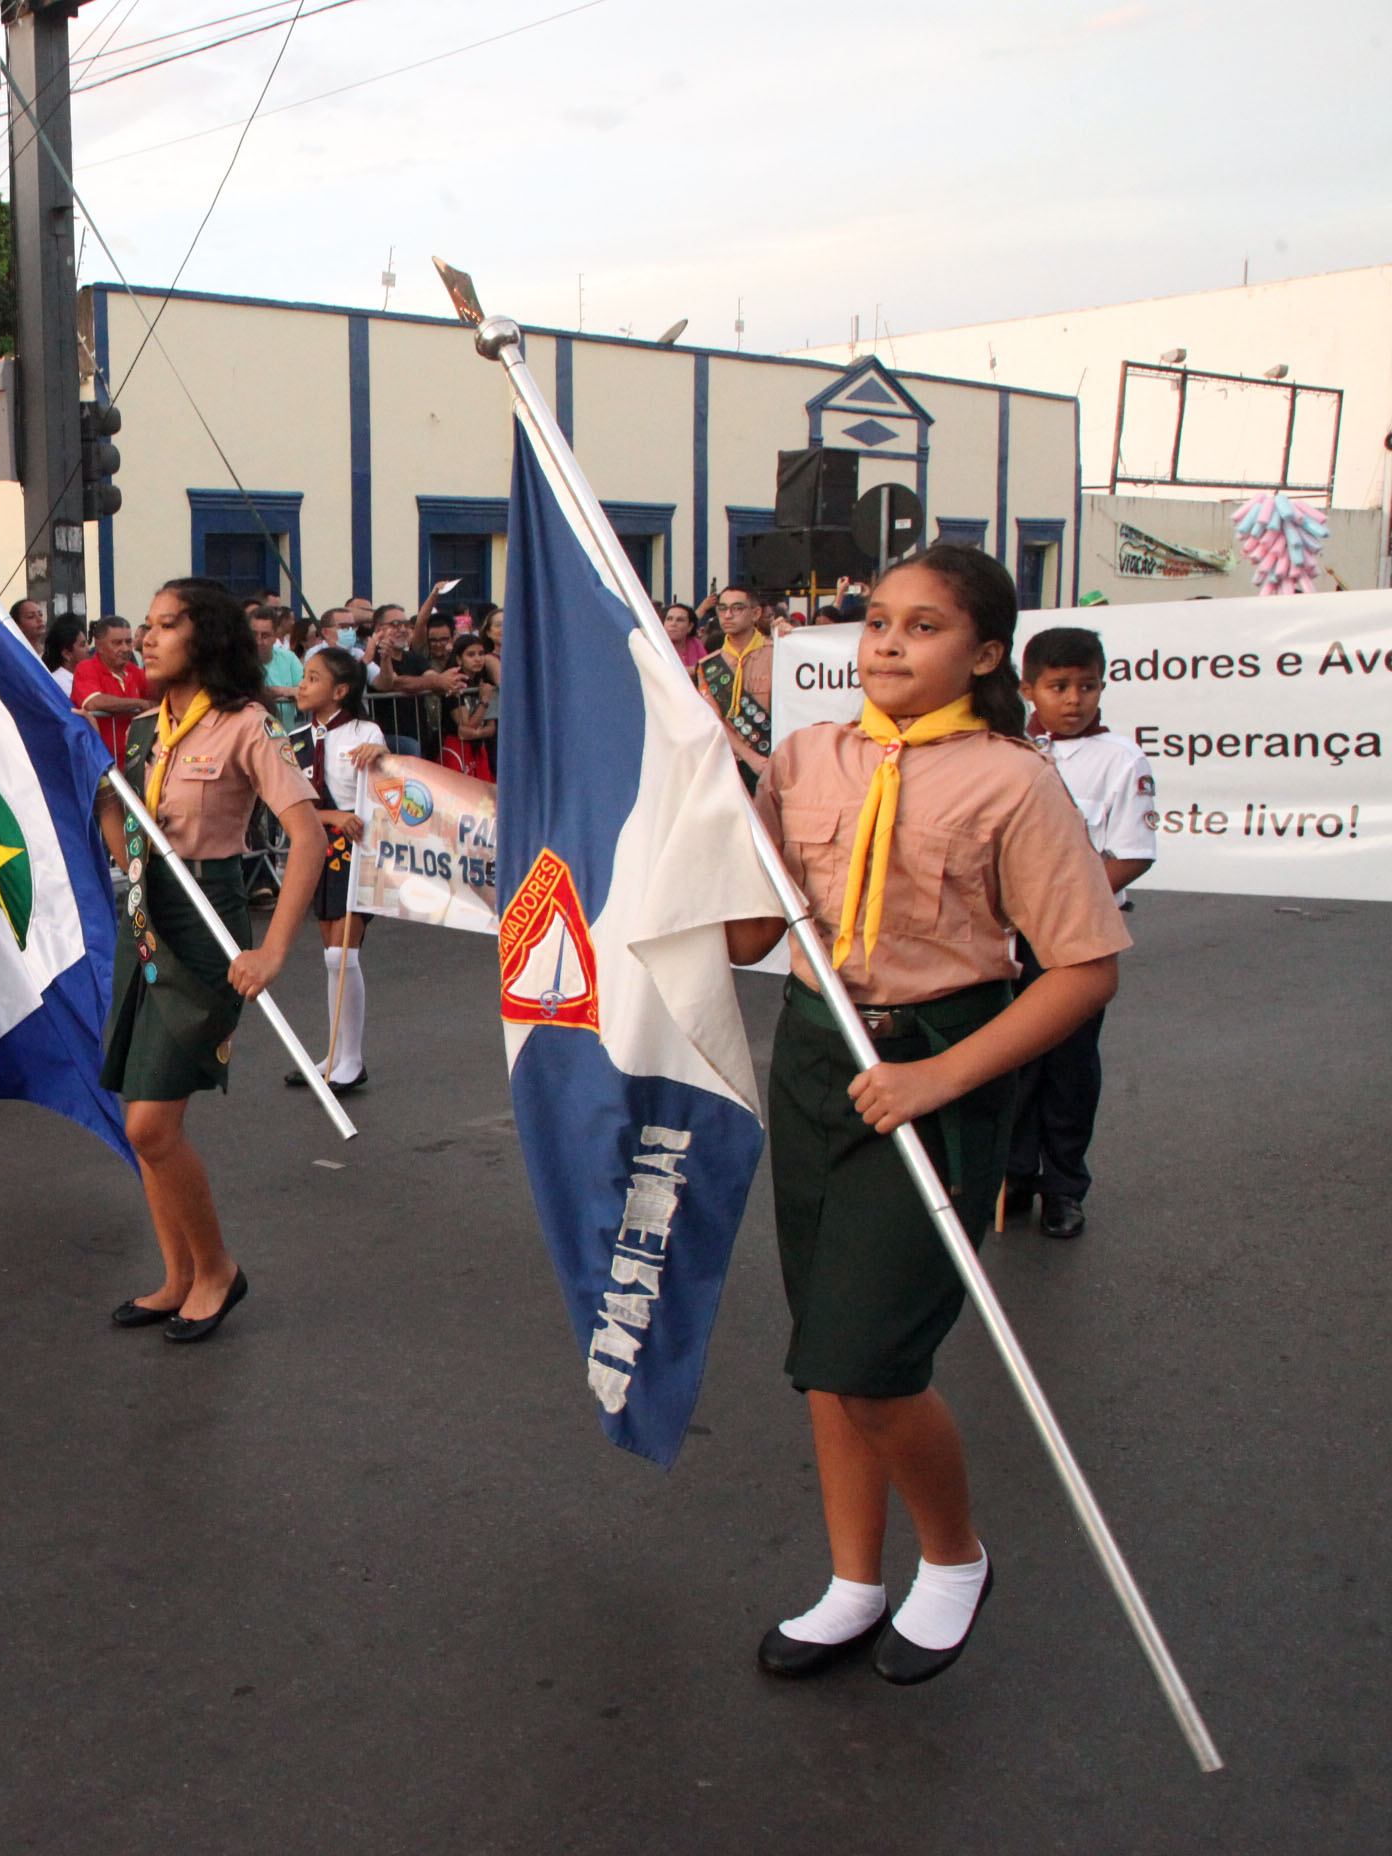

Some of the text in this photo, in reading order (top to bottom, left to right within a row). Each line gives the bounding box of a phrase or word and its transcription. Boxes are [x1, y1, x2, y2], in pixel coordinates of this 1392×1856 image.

[1276, 651, 1303, 677] e
[1135, 725, 1382, 766] Esperança
[1244, 803, 1360, 839] livro!
[377, 841, 453, 881] PELOS
[501, 858, 558, 958] AVADORES
